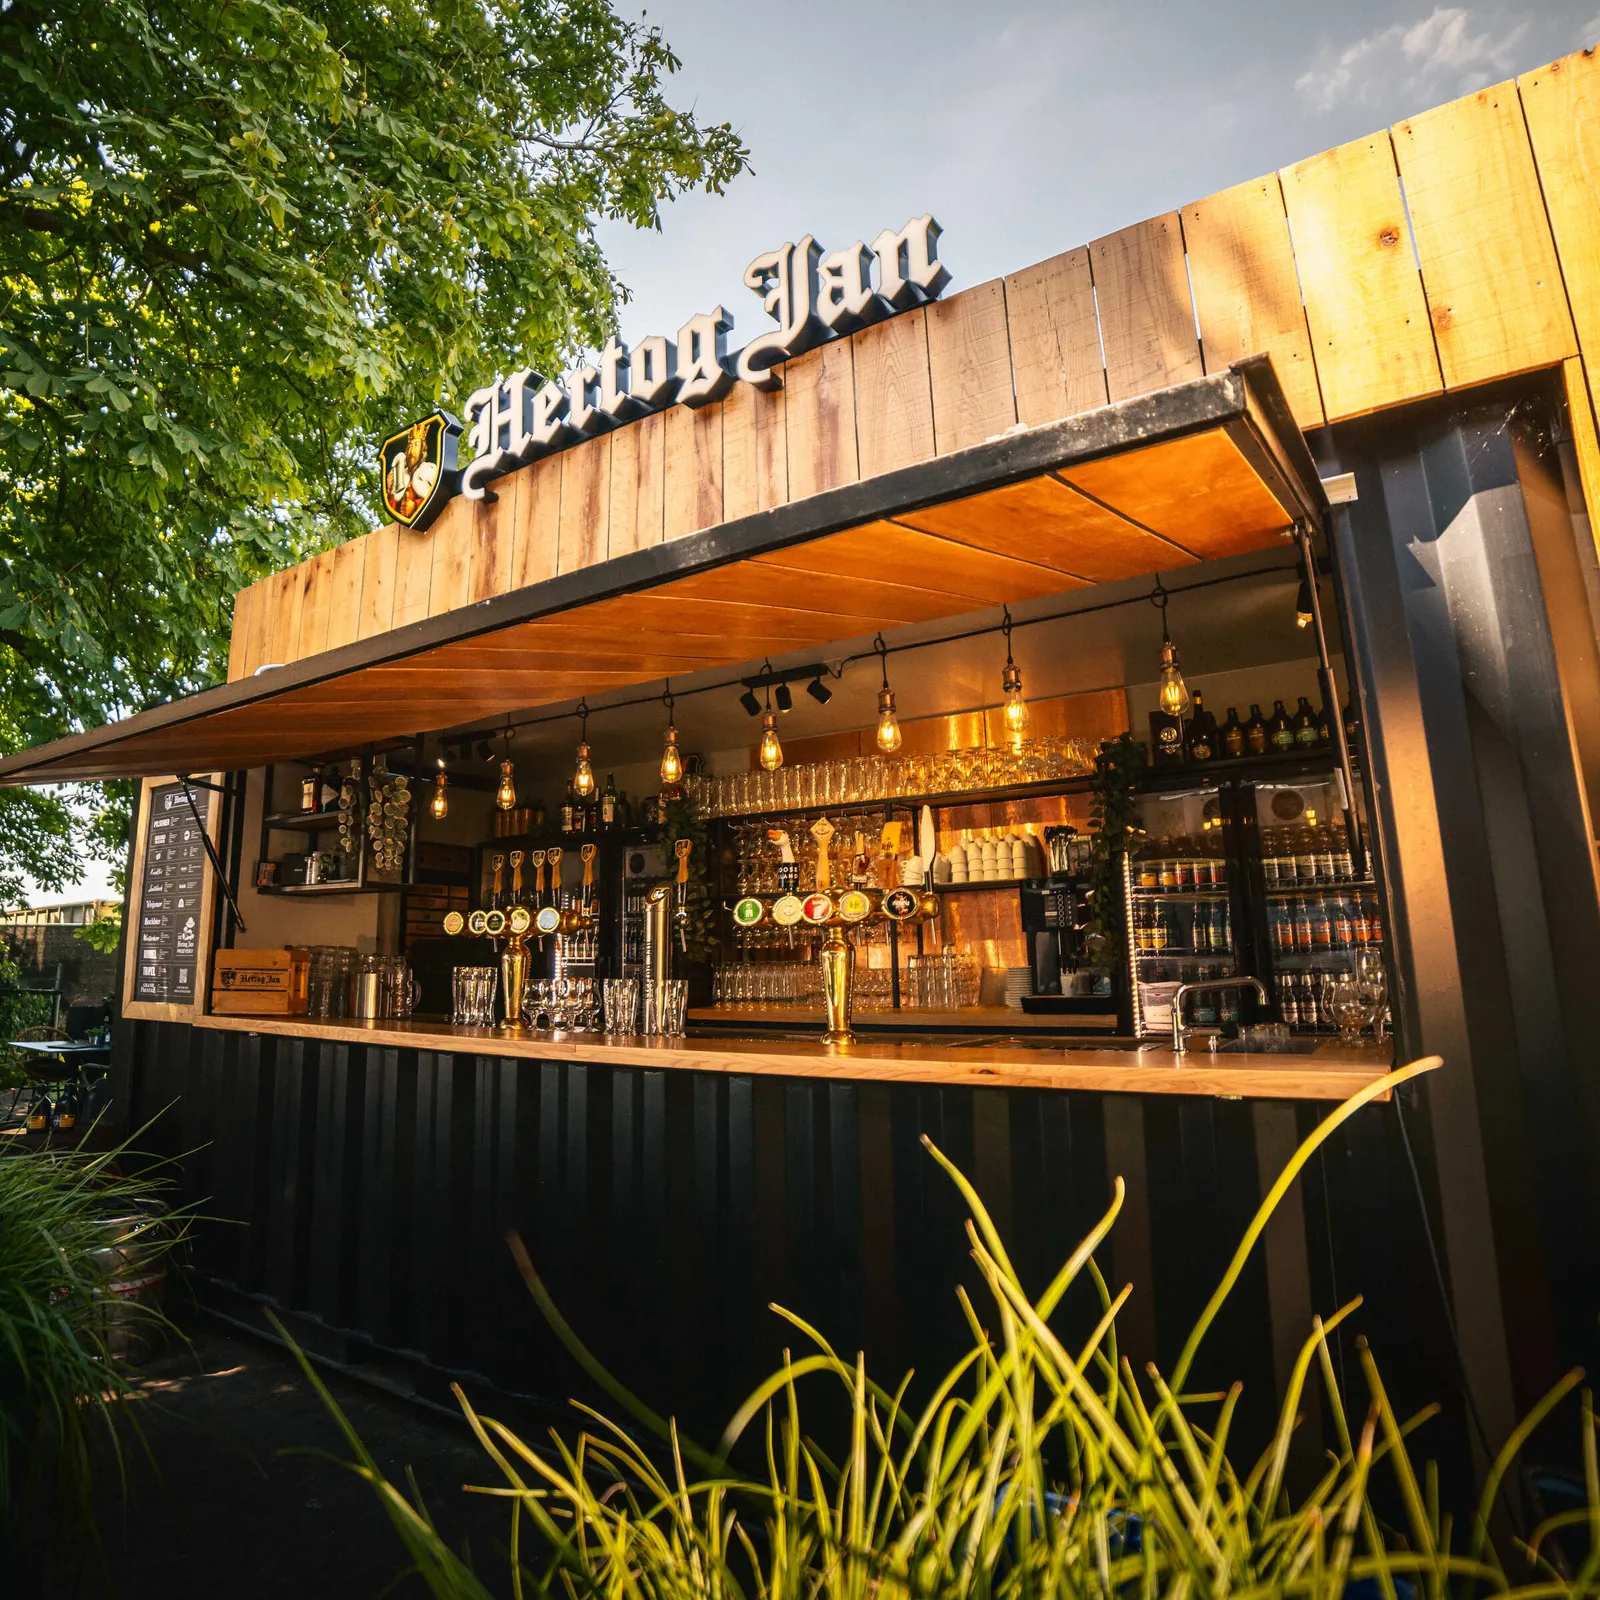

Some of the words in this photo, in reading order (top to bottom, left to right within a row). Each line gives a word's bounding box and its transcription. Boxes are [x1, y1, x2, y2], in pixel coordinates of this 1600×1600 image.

[461, 304, 733, 502] Hertog
[736, 213, 949, 388] Jan
[240, 975, 265, 984] Hertog
[265, 975, 281, 984] Jan
